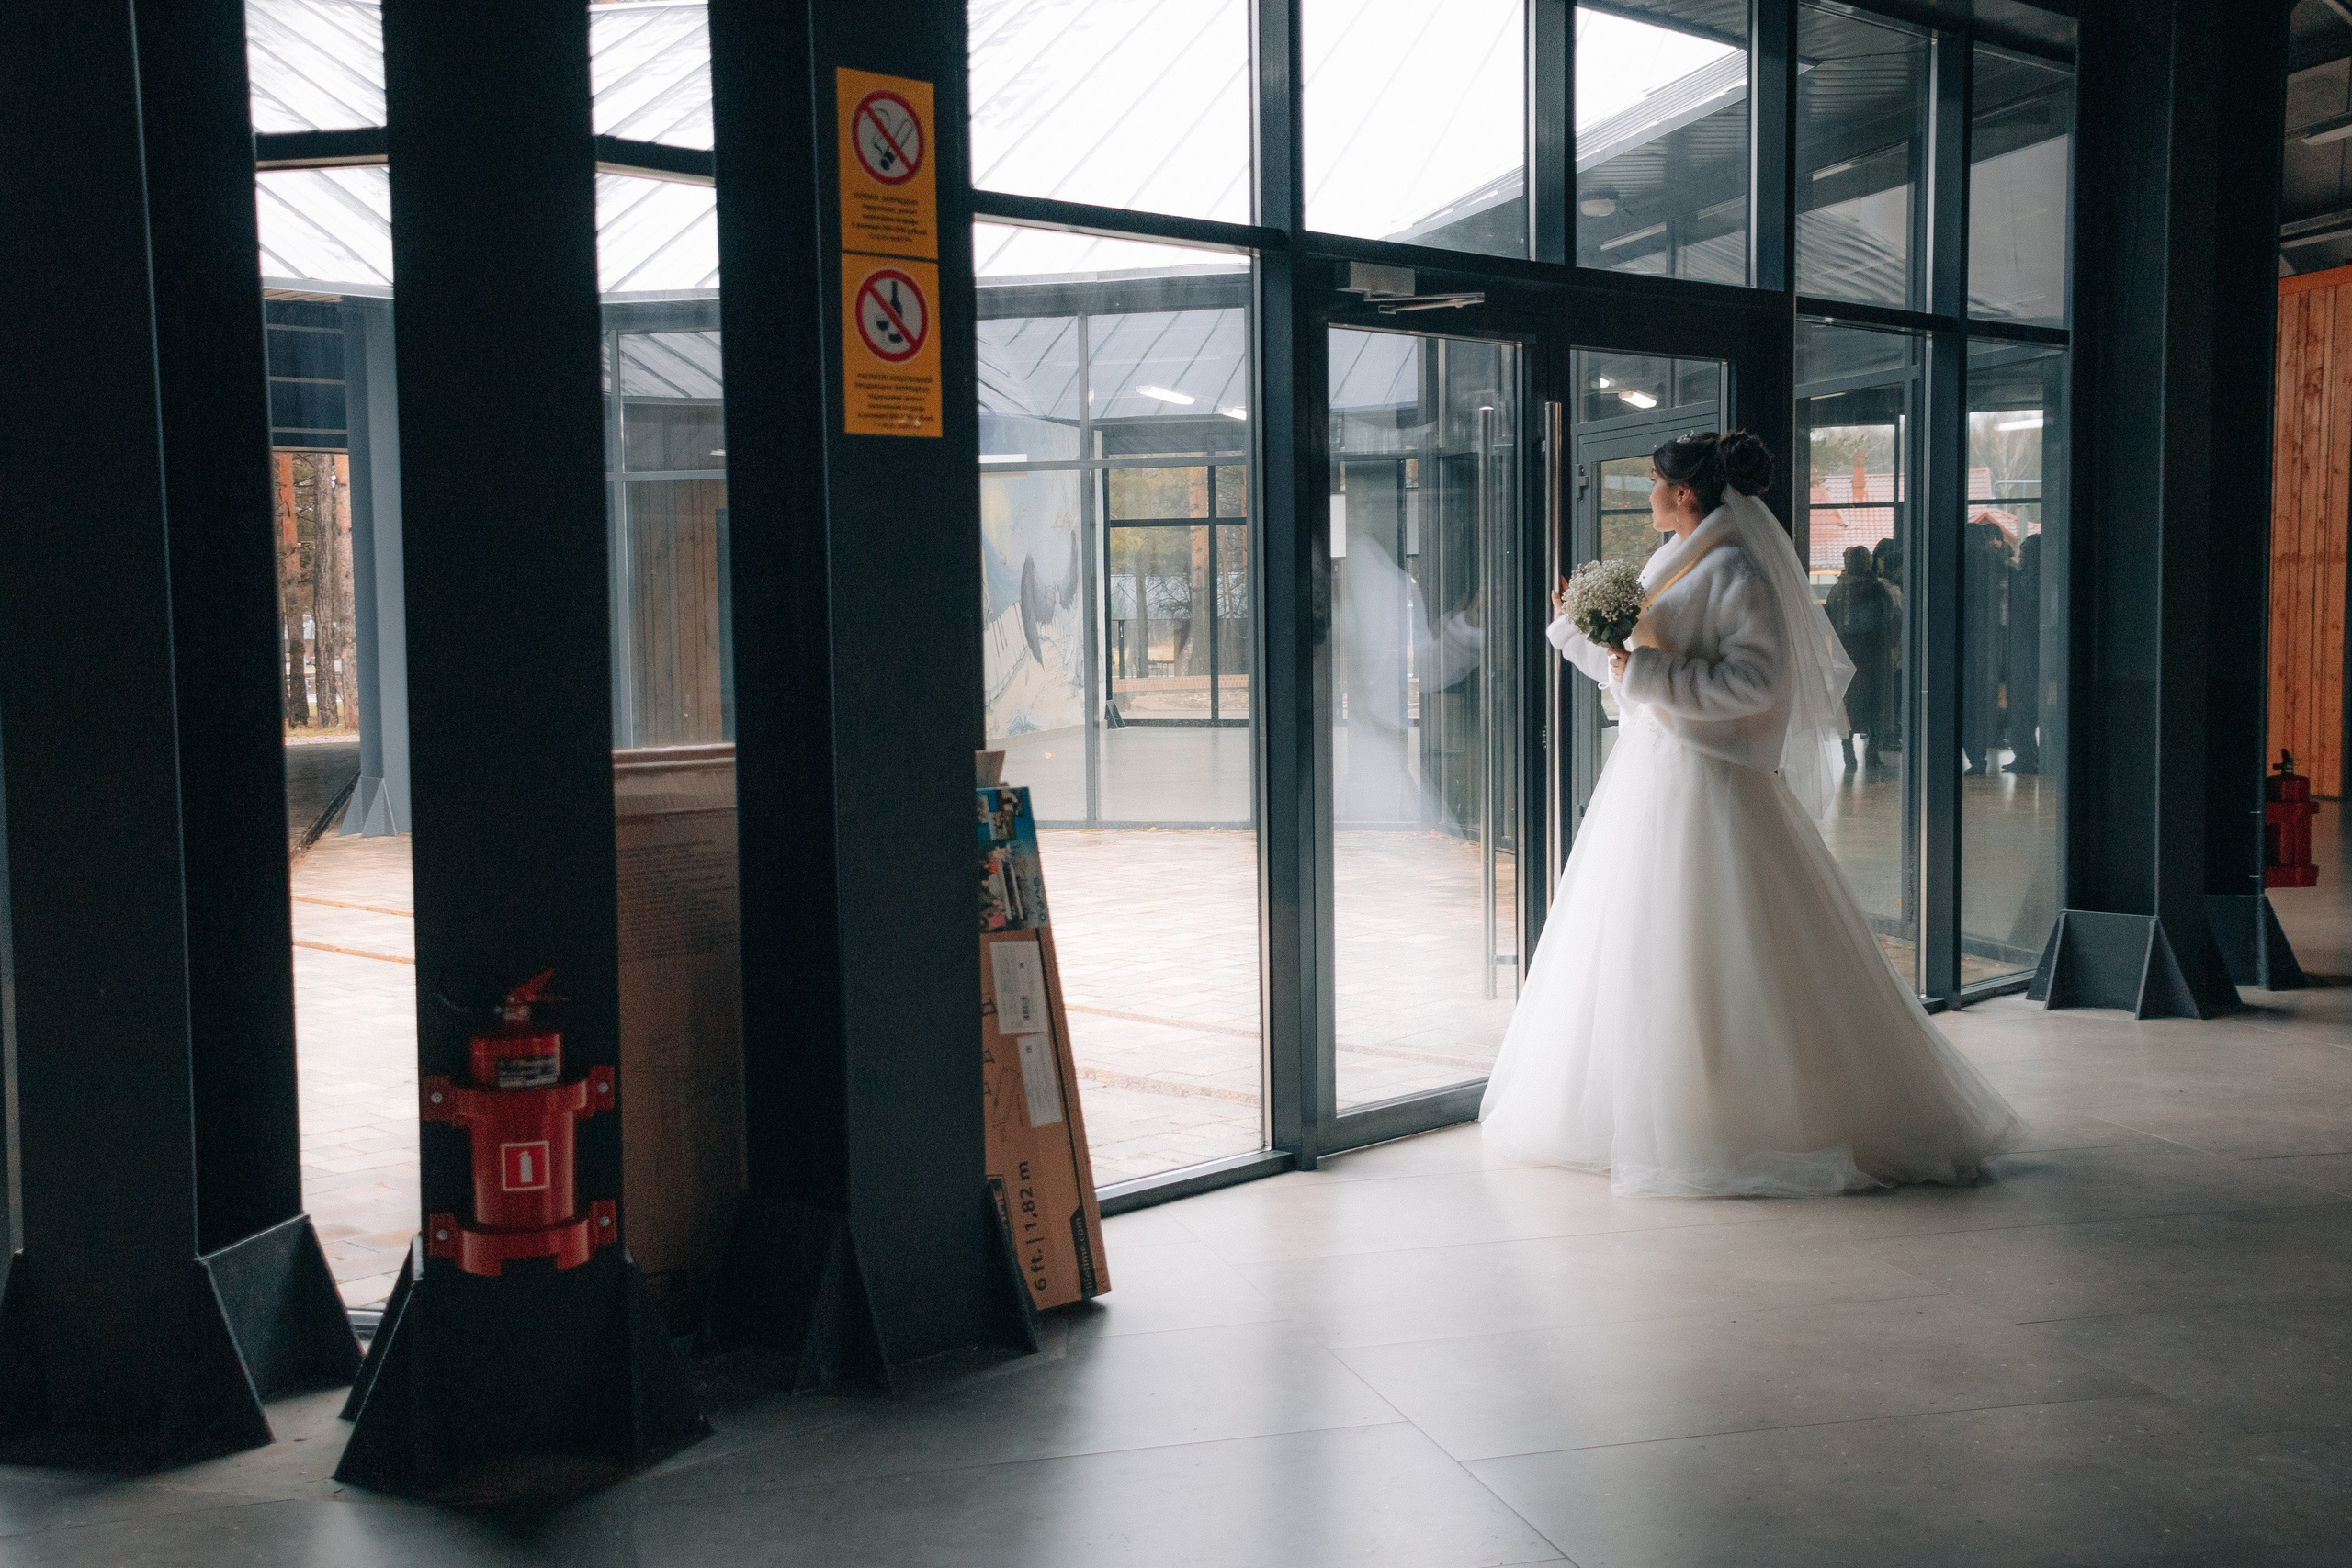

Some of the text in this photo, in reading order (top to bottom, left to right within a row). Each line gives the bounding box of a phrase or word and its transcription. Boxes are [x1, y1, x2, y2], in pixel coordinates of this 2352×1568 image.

[1018, 1160, 1030, 1181] m
[1019, 1186, 1038, 1232] 1,82
[1030, 1248, 1045, 1273] ft.
[1076, 1217, 1093, 1290] lifetime.com
[1034, 1278, 1047, 1291] 6
